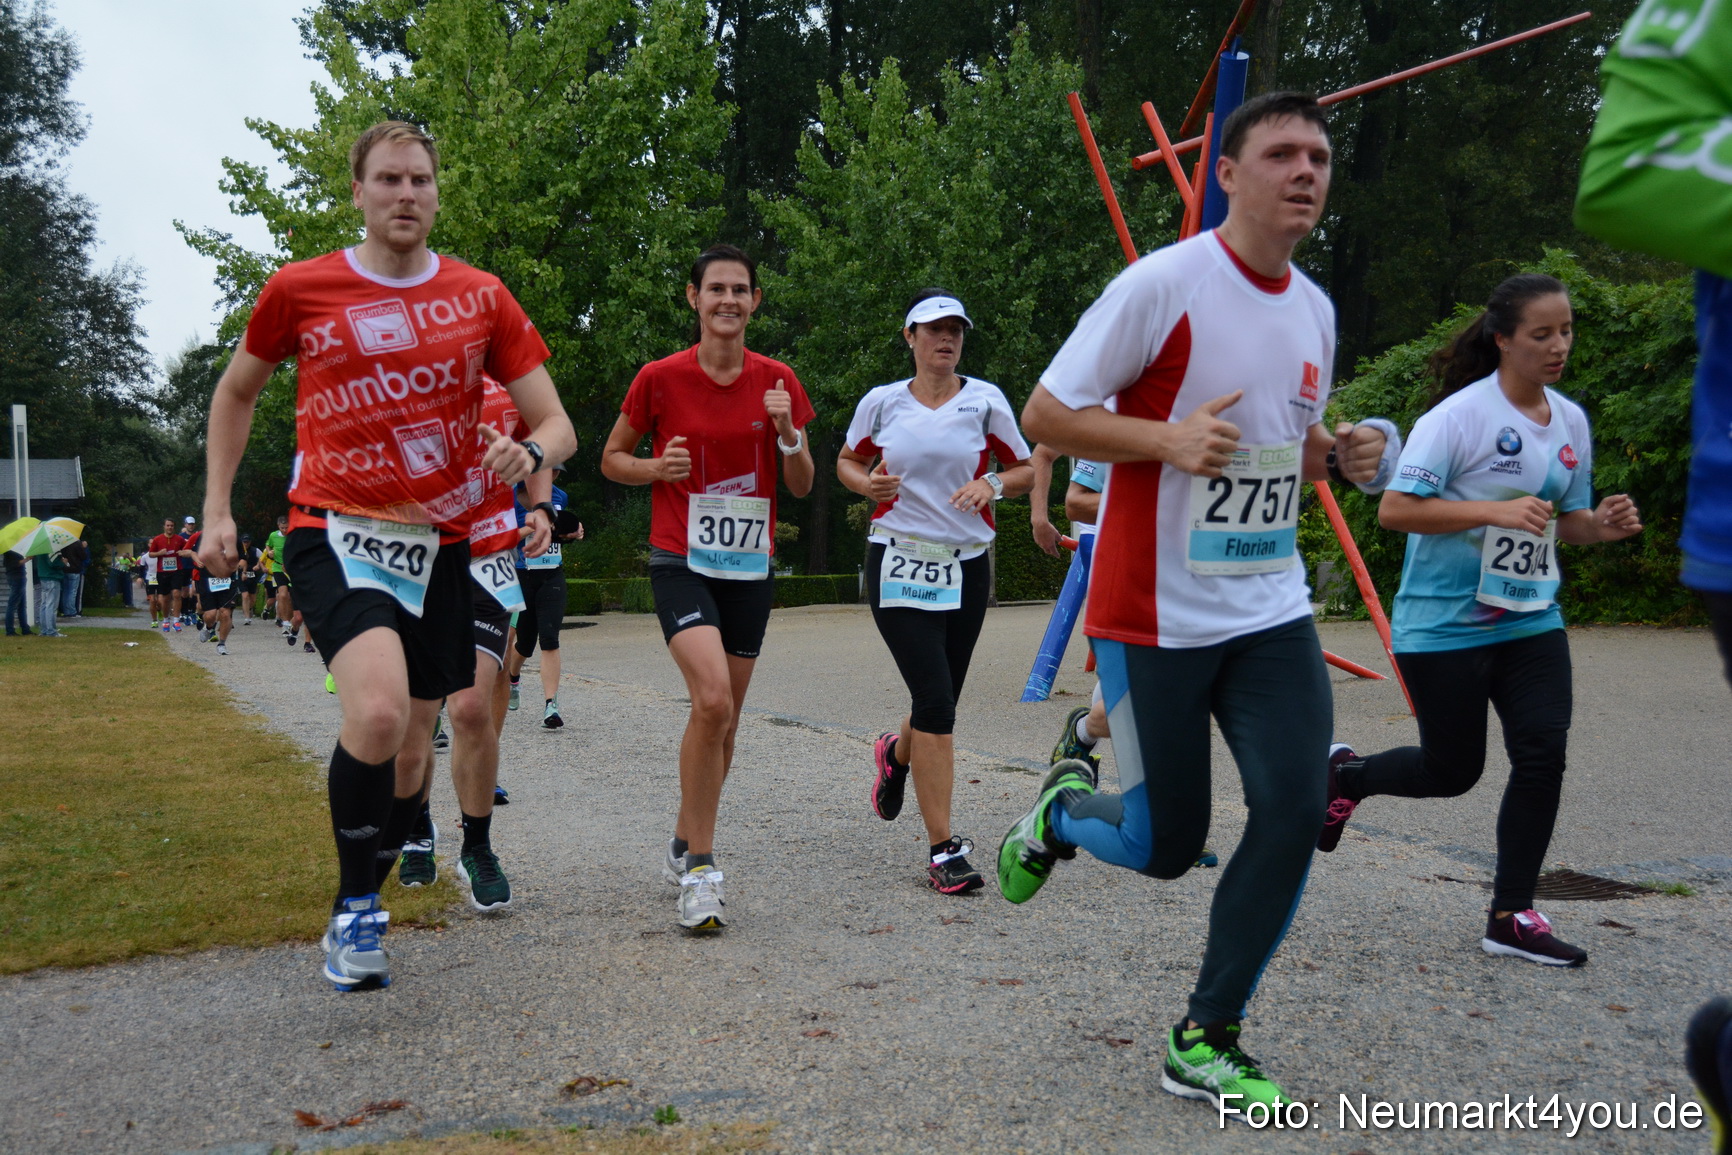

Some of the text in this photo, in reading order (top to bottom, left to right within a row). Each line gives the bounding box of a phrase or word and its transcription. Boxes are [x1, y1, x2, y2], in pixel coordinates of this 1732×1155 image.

[351, 304, 402, 320] raumbox
[306, 358, 460, 420] raumbox
[362, 408, 409, 424] wohnen
[418, 391, 462, 412] outdoor
[397, 424, 442, 441] raumbox
[1400, 464, 1441, 488] BOCK
[719, 482, 743, 495] DEHN
[1205, 474, 1297, 525] 2757
[379, 520, 430, 537] BOCK
[698, 515, 766, 549] 3077
[343, 531, 428, 577] 2620
[1225, 537, 1276, 557] Florian
[889, 555, 953, 586] 2751
[902, 586, 937, 601] Melitta
[474, 619, 504, 637] saller
